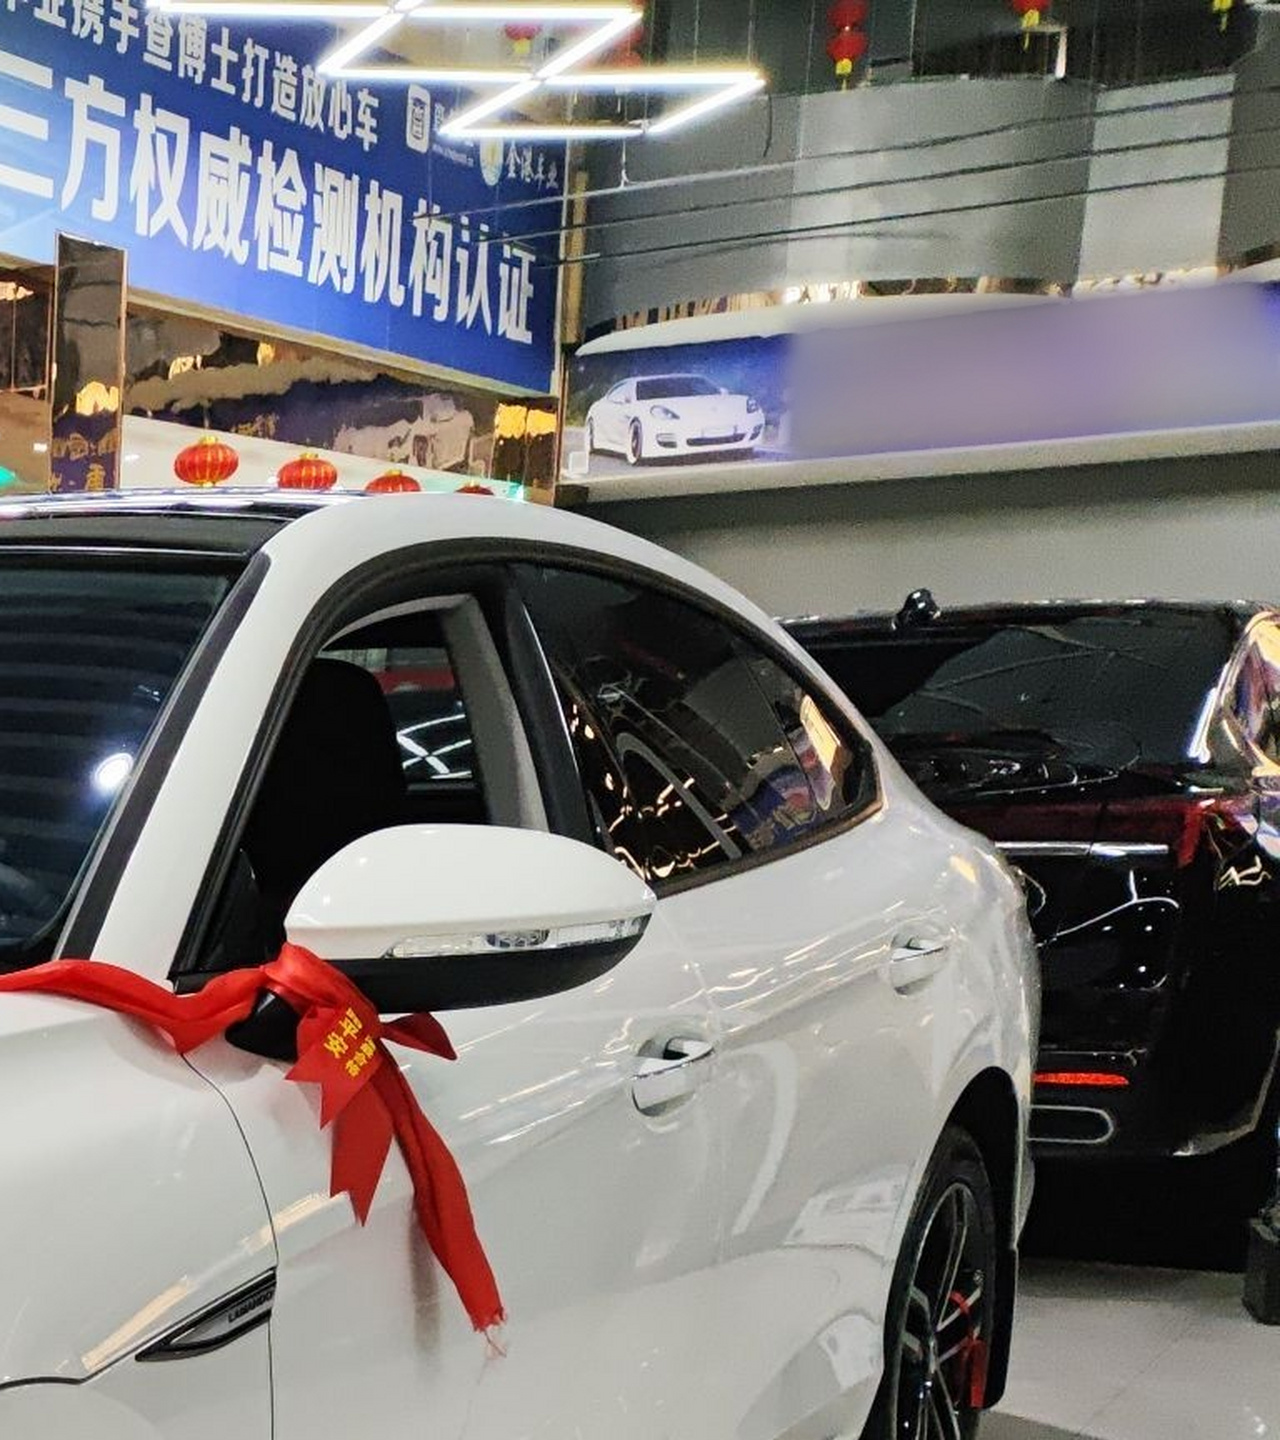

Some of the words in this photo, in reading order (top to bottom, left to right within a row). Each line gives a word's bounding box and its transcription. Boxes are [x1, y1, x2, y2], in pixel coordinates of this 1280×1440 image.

[5, 0, 380, 152] 携手查博士打造放心车
